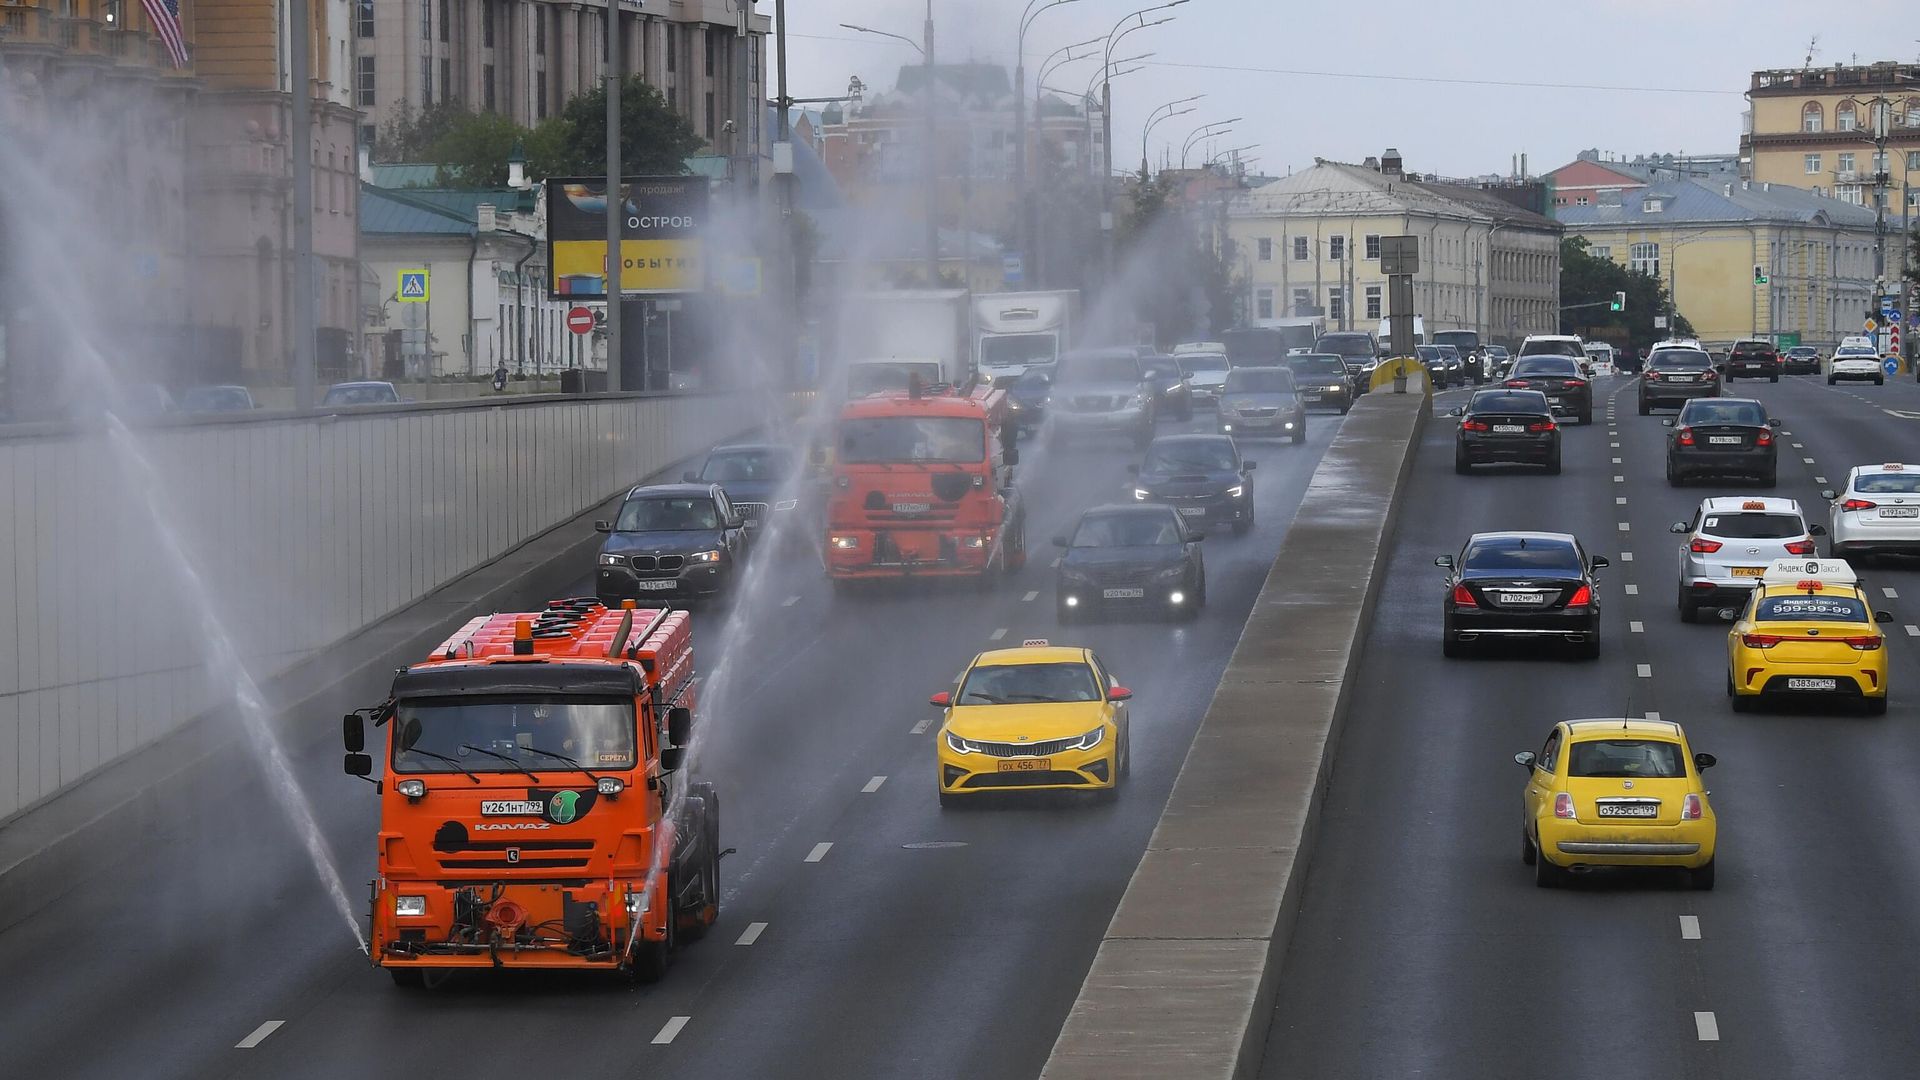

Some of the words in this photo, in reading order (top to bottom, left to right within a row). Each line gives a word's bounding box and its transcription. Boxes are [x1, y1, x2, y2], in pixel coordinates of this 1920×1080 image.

[1778, 563, 1804, 573] Яндекс
[1806, 562, 1818, 574] Go
[1820, 564, 1840, 573] Такси
[1773, 604, 1852, 615] 999-99-99
[1002, 763, 1013, 771] ОХ
[1017, 761, 1034, 770] 456
[485, 802, 524, 813] У261НТ
[526, 801, 541, 811] 799
[1601, 806, 1640, 815] О925СС
[1641, 805, 1655, 813] 199
[474, 823, 551, 831] KAMAZ
